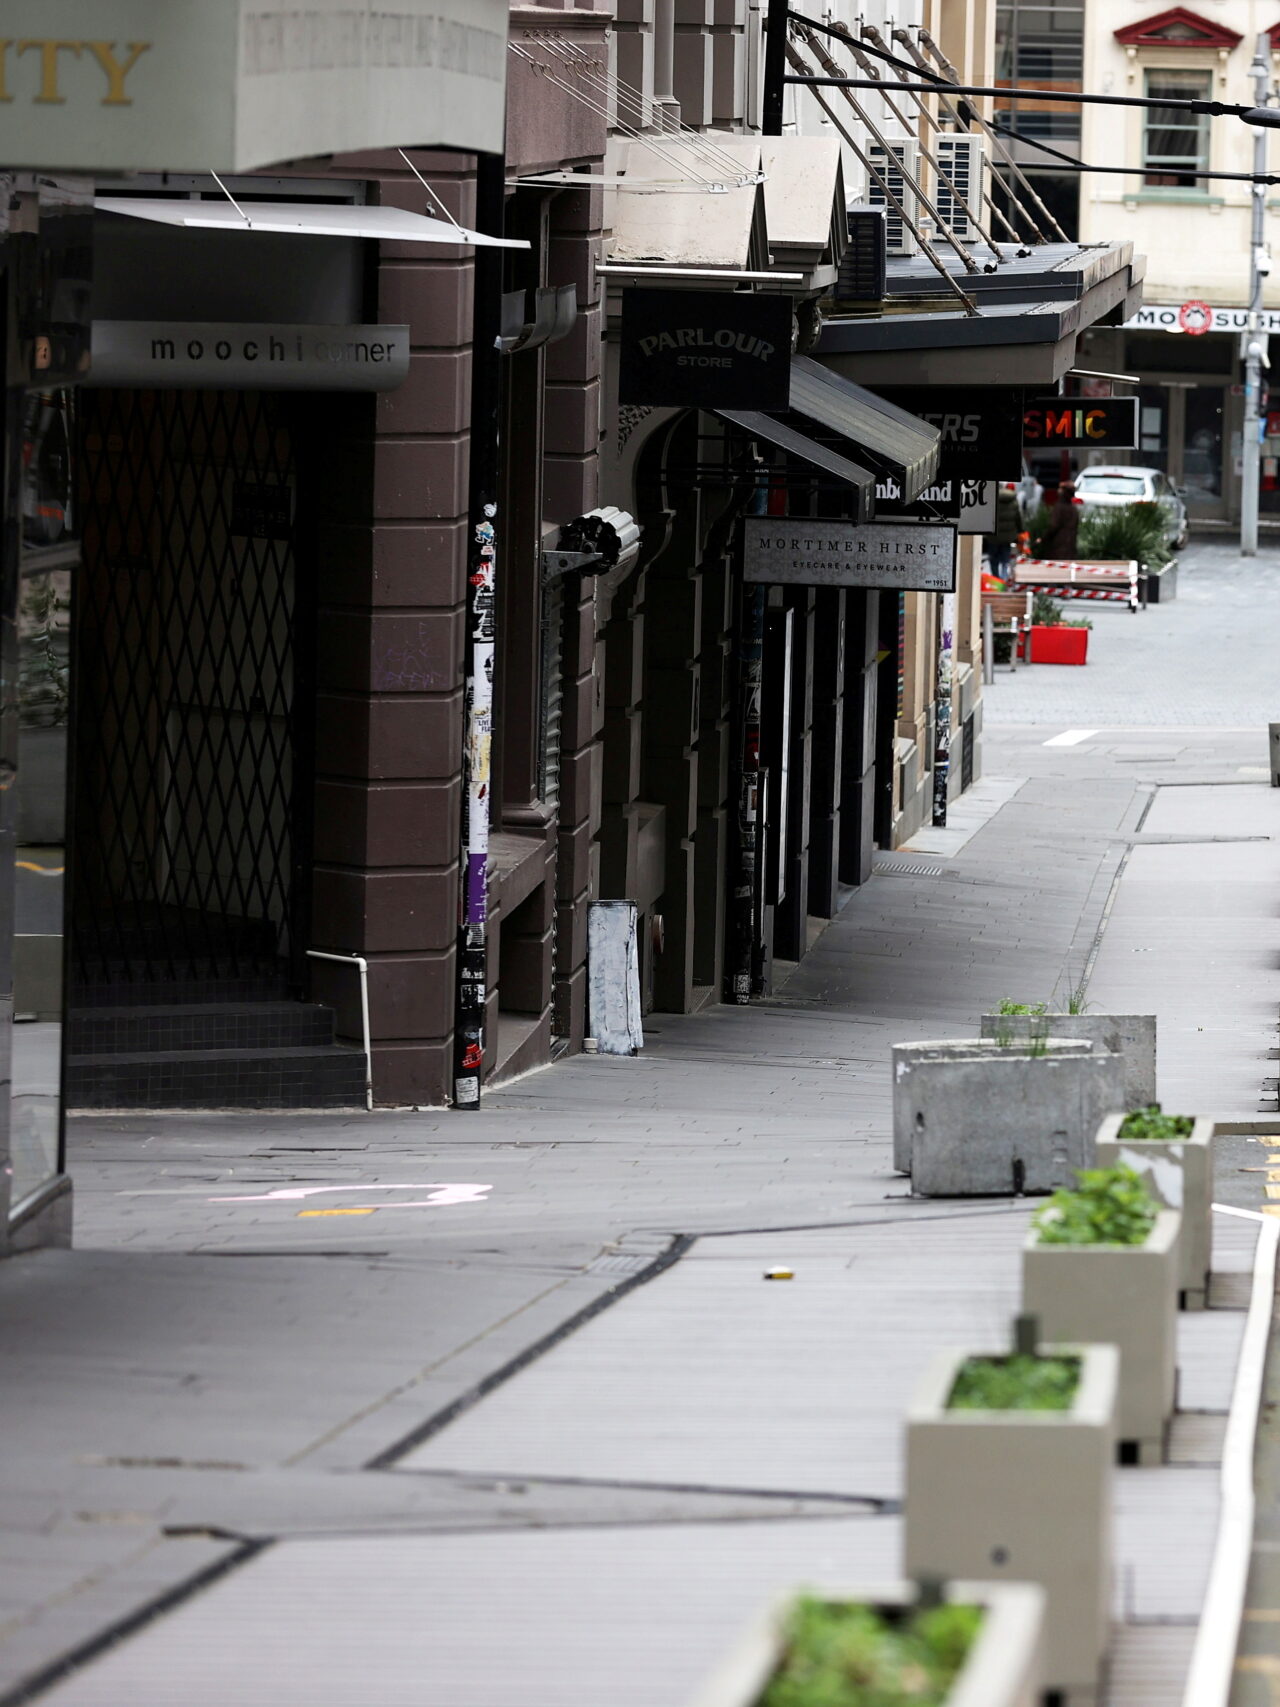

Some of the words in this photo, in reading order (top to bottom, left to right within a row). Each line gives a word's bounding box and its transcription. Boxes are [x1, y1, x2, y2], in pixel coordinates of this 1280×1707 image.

[151, 335, 302, 361] moochi
[638, 328, 775, 362] PARLOUR
[676, 355, 732, 368] STORE
[759, 538, 868, 553] MORTIMER
[879, 542, 940, 555] HIRST
[793, 561, 840, 570] EYECARE
[856, 563, 906, 572] EYEWEAR
[933, 579, 947, 587] 1951
